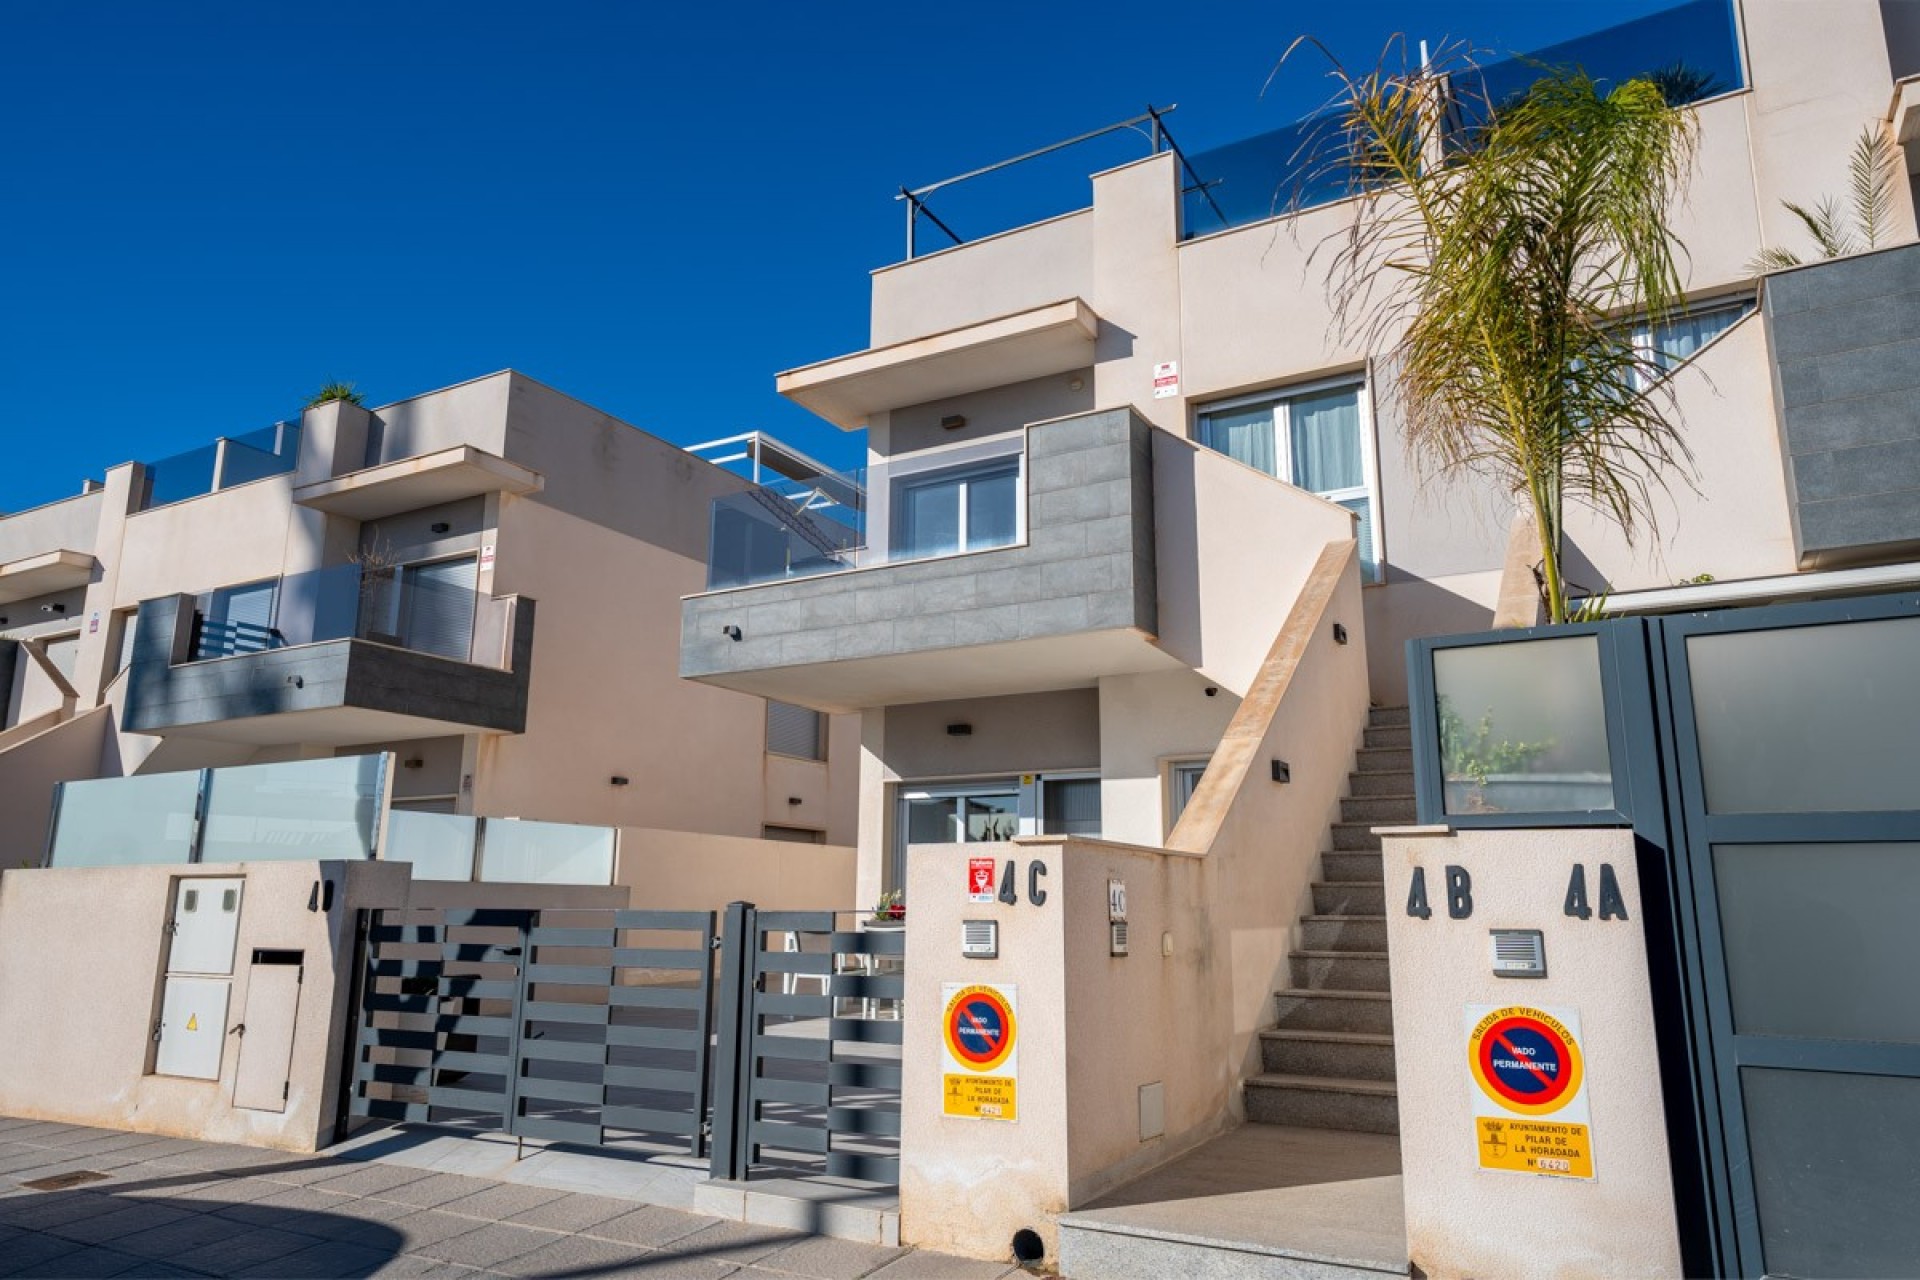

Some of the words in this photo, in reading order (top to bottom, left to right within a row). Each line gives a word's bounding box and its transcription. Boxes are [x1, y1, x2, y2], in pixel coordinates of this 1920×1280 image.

[998, 860, 1047, 907] 4C
[1406, 865, 1473, 920] 4B
[1564, 863, 1629, 920] 4A
[1472, 1012, 1501, 1041] SALIDA
[1500, 1007, 1516, 1018] DE
[1519, 1007, 1575, 1047] VEHICULOS
[1511, 1046, 1537, 1056] VADO
[1492, 1058, 1557, 1073] PERMANENTE
[1510, 1123, 1568, 1135] AYUNTAMIENTO
[1570, 1127, 1582, 1137] DE
[1525, 1134, 1552, 1145] PILAR
[1555, 1136, 1568, 1147] DE
[1515, 1144, 1526, 1154] LA
[1530, 1145, 1581, 1158] HORADADA
[1540, 1158, 1569, 1171] 6420
